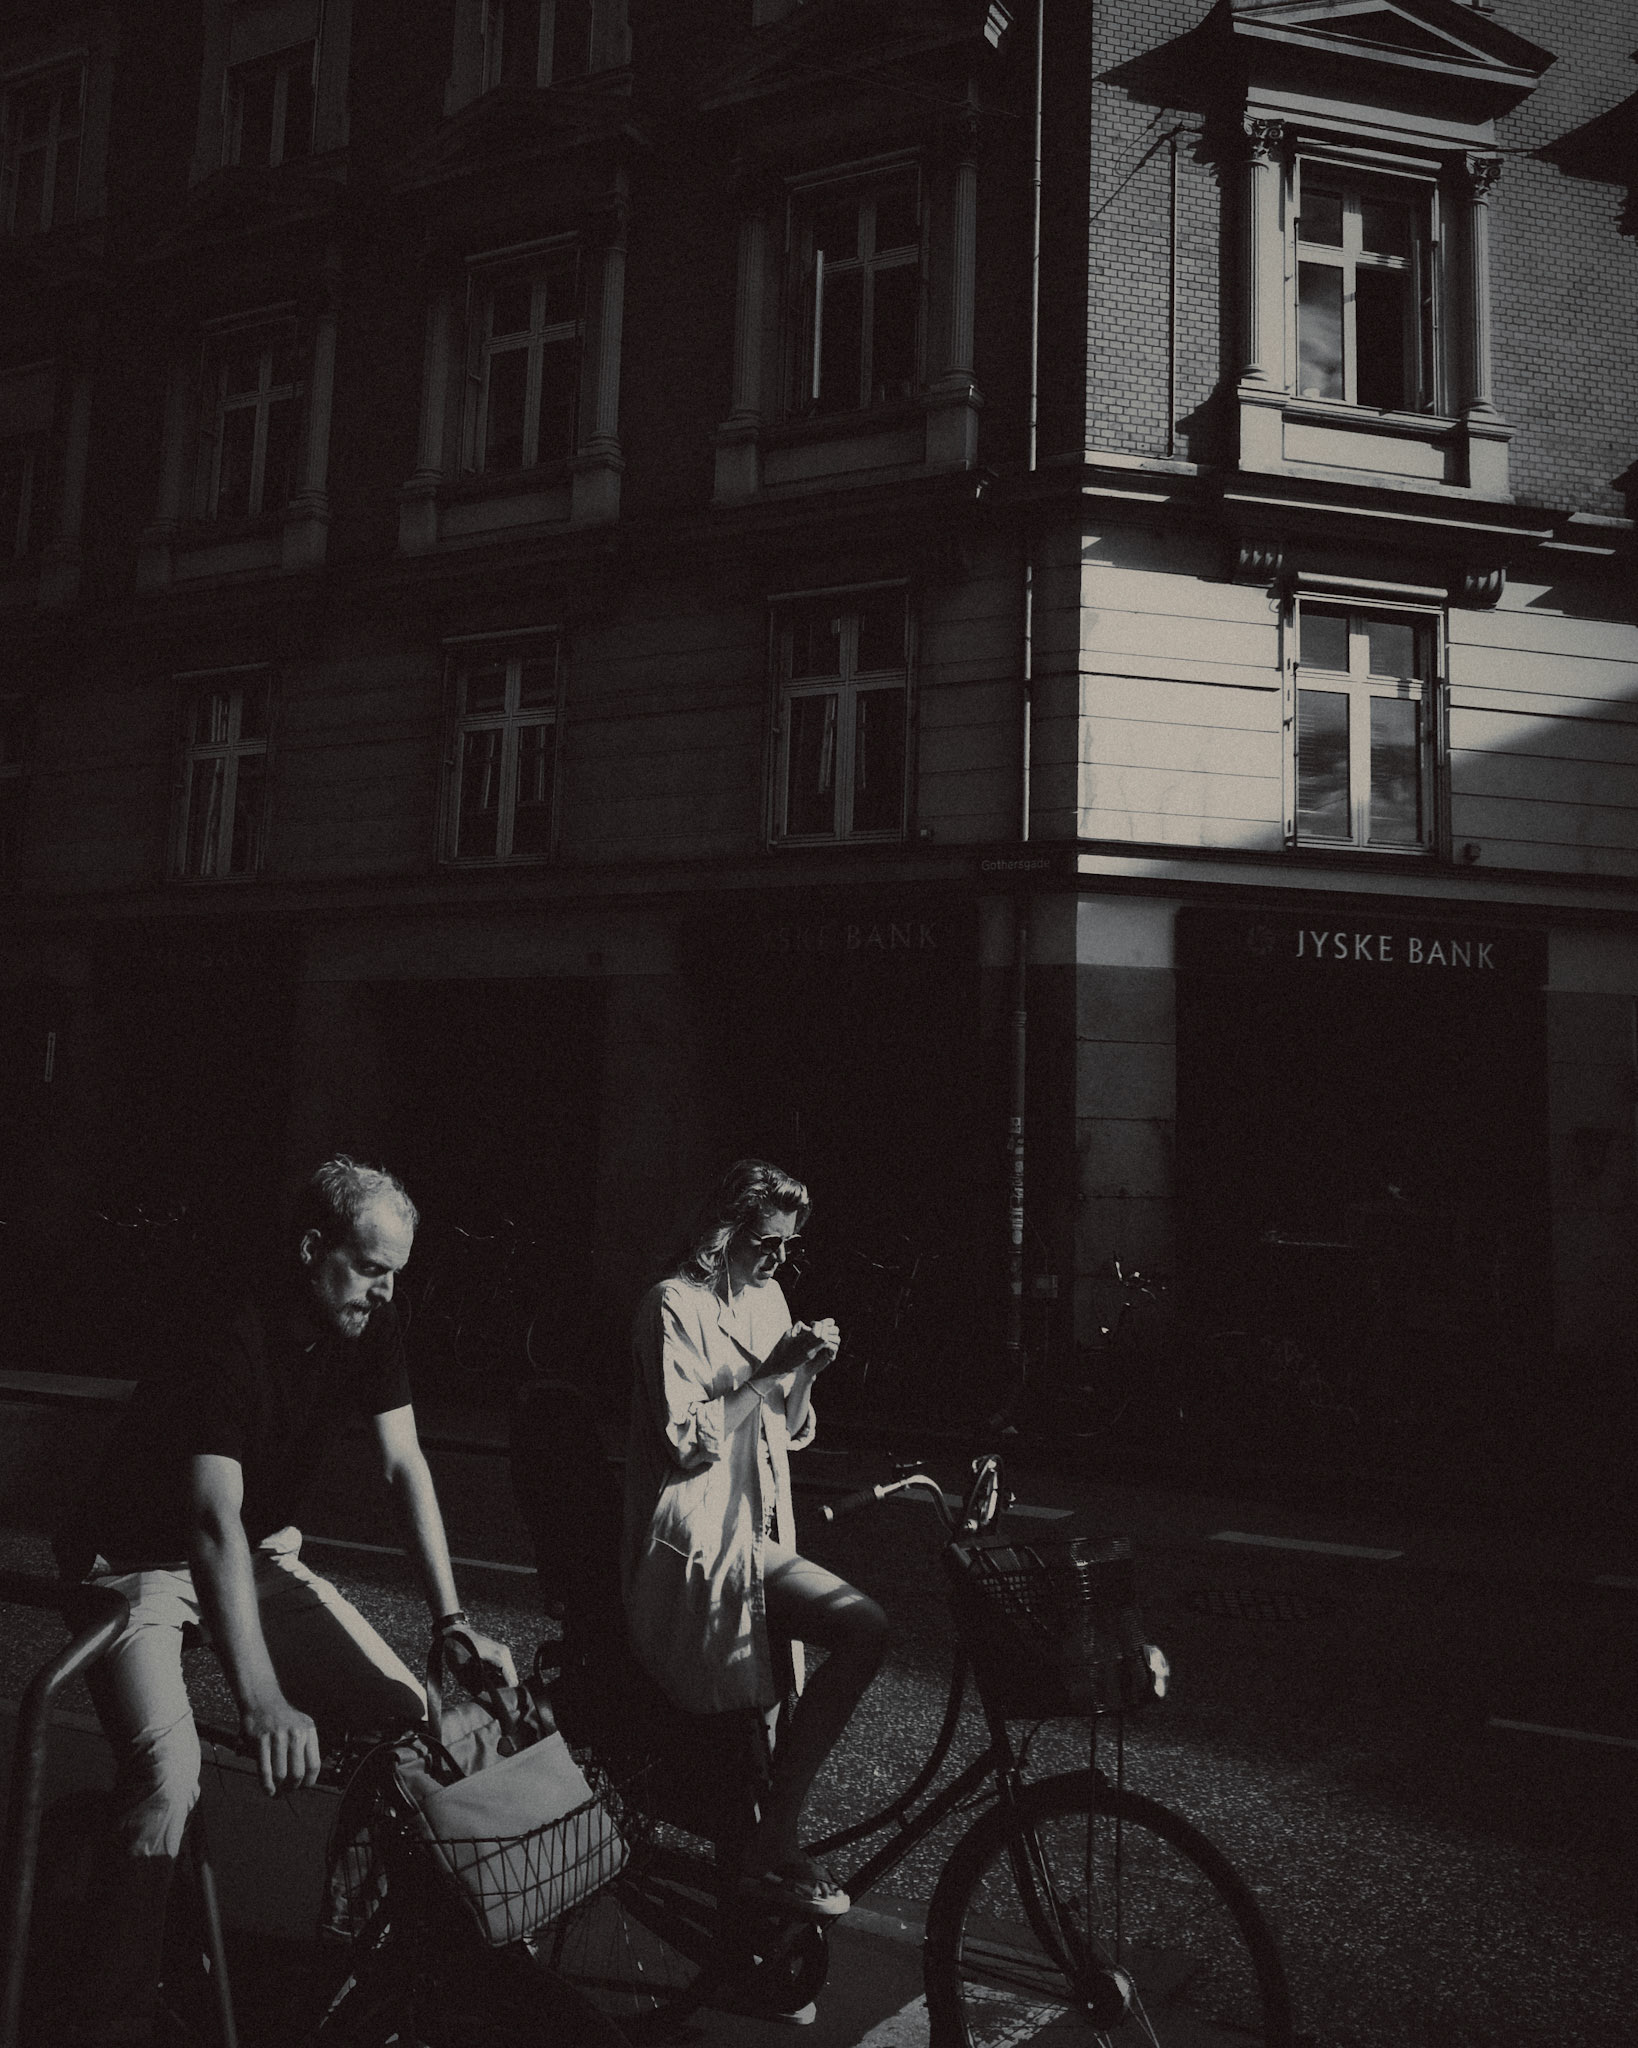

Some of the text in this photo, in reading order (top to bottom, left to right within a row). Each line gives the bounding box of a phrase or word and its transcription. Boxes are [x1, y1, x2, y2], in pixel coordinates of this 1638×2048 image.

[981, 858, 1050, 871] Gothersgade
[846, 922, 937, 950] BANK
[1296, 930, 1495, 969] JYSKE BANK
